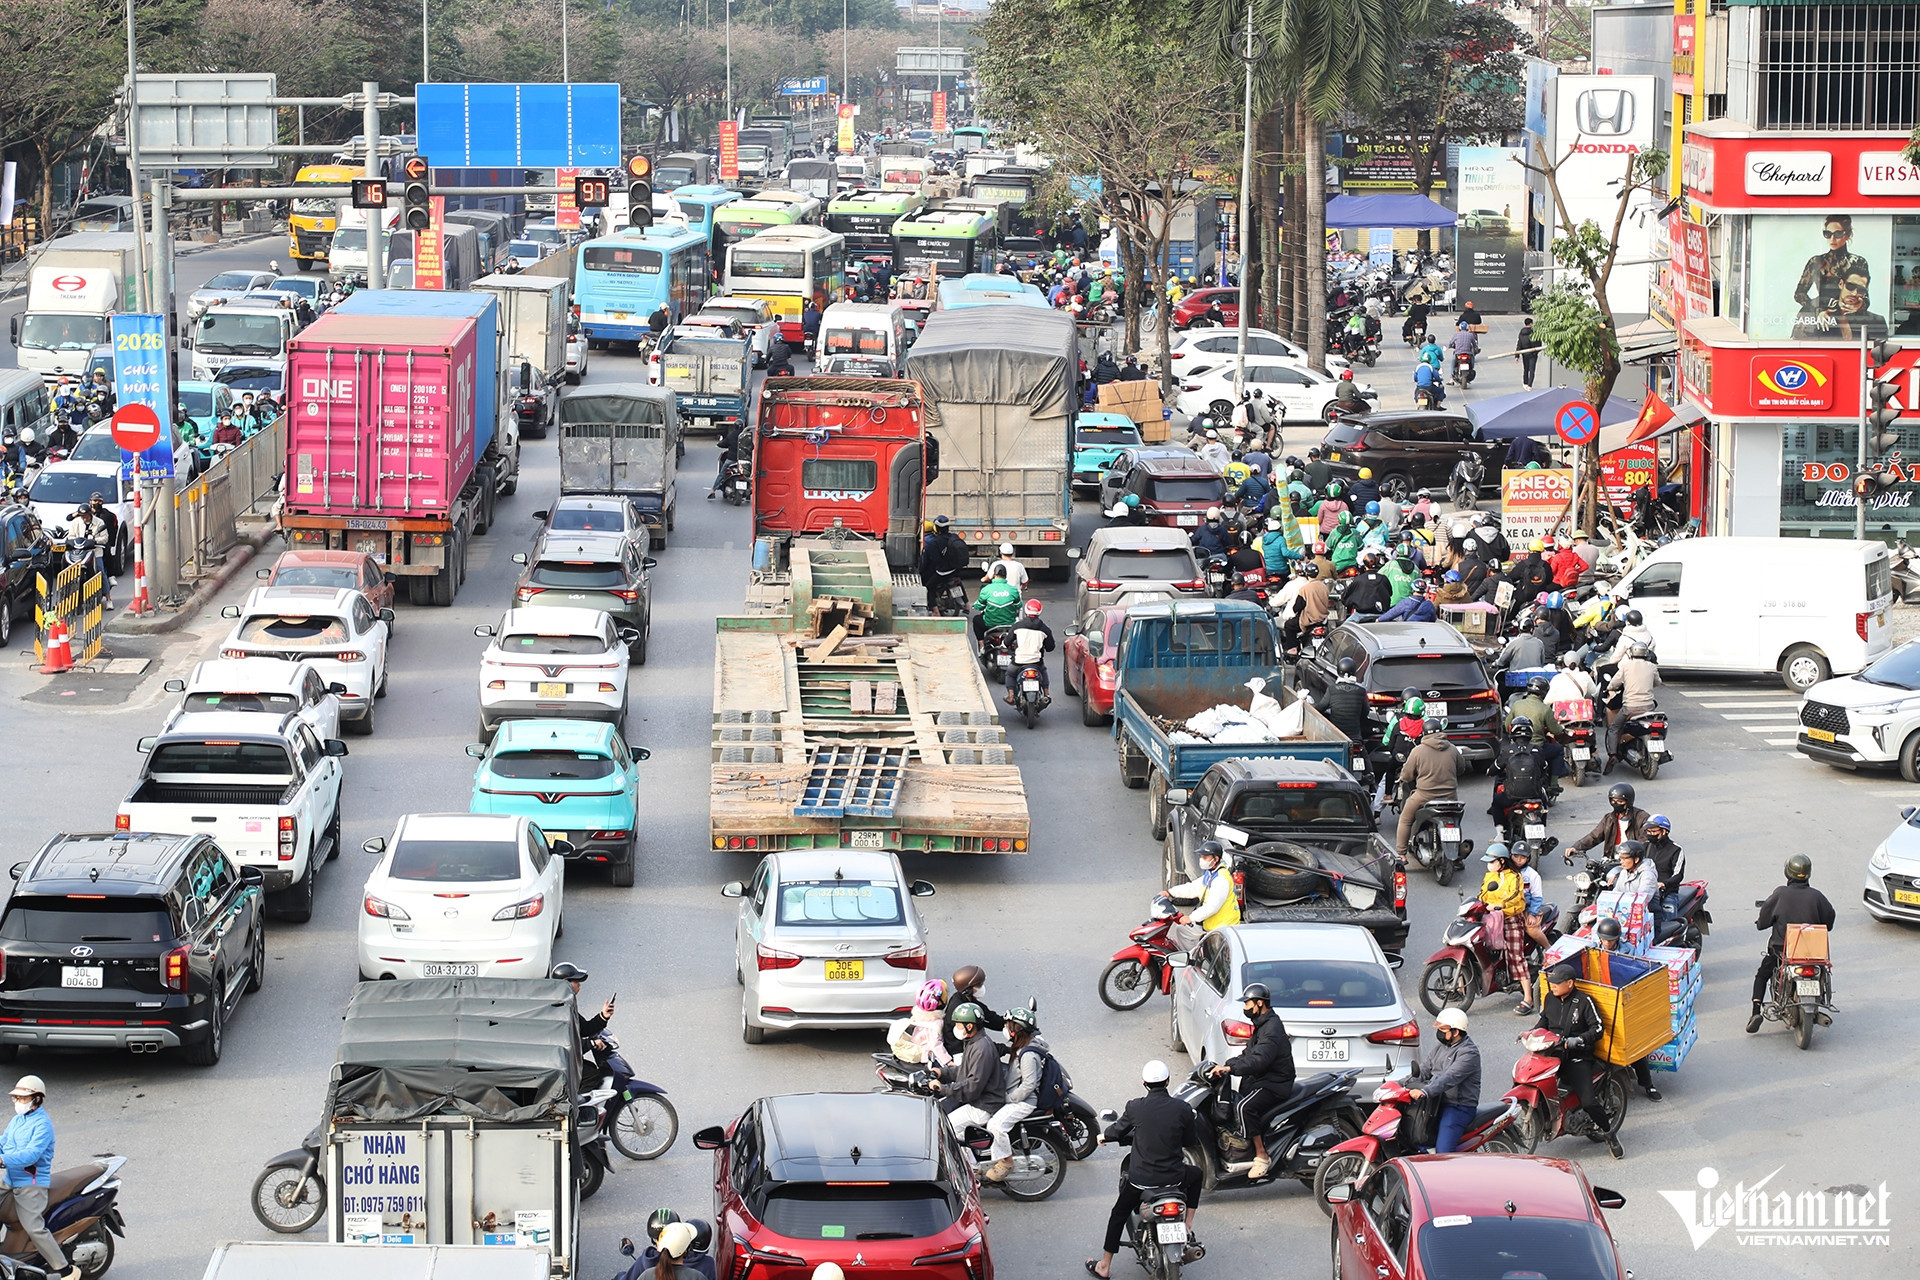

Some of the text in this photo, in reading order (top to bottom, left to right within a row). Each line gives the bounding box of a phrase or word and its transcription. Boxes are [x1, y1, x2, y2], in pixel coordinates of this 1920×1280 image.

[1569, 144, 1640, 154] HONDA
[1753, 162, 1826, 185] Chopard
[1864, 166, 1920, 181] VERSA
[368, 185, 382, 203] 16
[583, 183, 605, 201] 97
[1791, 317, 1838, 326] GABBANA
[117, 333, 163, 351] 2026
[123, 361, 158, 376] CHÚC
[303, 379, 353, 399] ONE
[390, 384, 406, 393] ONEU
[413, 385, 437, 394] 200182
[1619, 460, 1625, 469] 7
[1802, 451, 1920, 482] ĐO ẮT
[1508, 476, 1571, 490] ENEOS
[804, 490, 874, 502] LUXURY
[1509, 490, 1550, 500] MOTOR
[1544, 515, 1572, 523] MOTOR
[346, 520, 387, 529] 15R-024.43
[1506, 529, 1519, 538] XE
[1522, 529, 1534, 538] GA
[854, 840, 880, 848] 000.16
[29, 958, 134, 966] PALISADE
[836, 961, 852, 971] 30E
[74, 968, 90, 977] 30L
[426, 965, 476, 975] 30A-321.23
[829, 971, 860, 980] 008.89
[66, 978, 98, 987] 004.60
[1320, 1040, 1337, 1050] 30K
[1312, 1050, 1345, 1060] 697.18
[363, 1132, 406, 1158] NHẬN
[344, 1158, 420, 1185] CHỞ HÀNG
[387, 1196, 404, 1213] 759
[407, 1195, 424, 1212] 611
